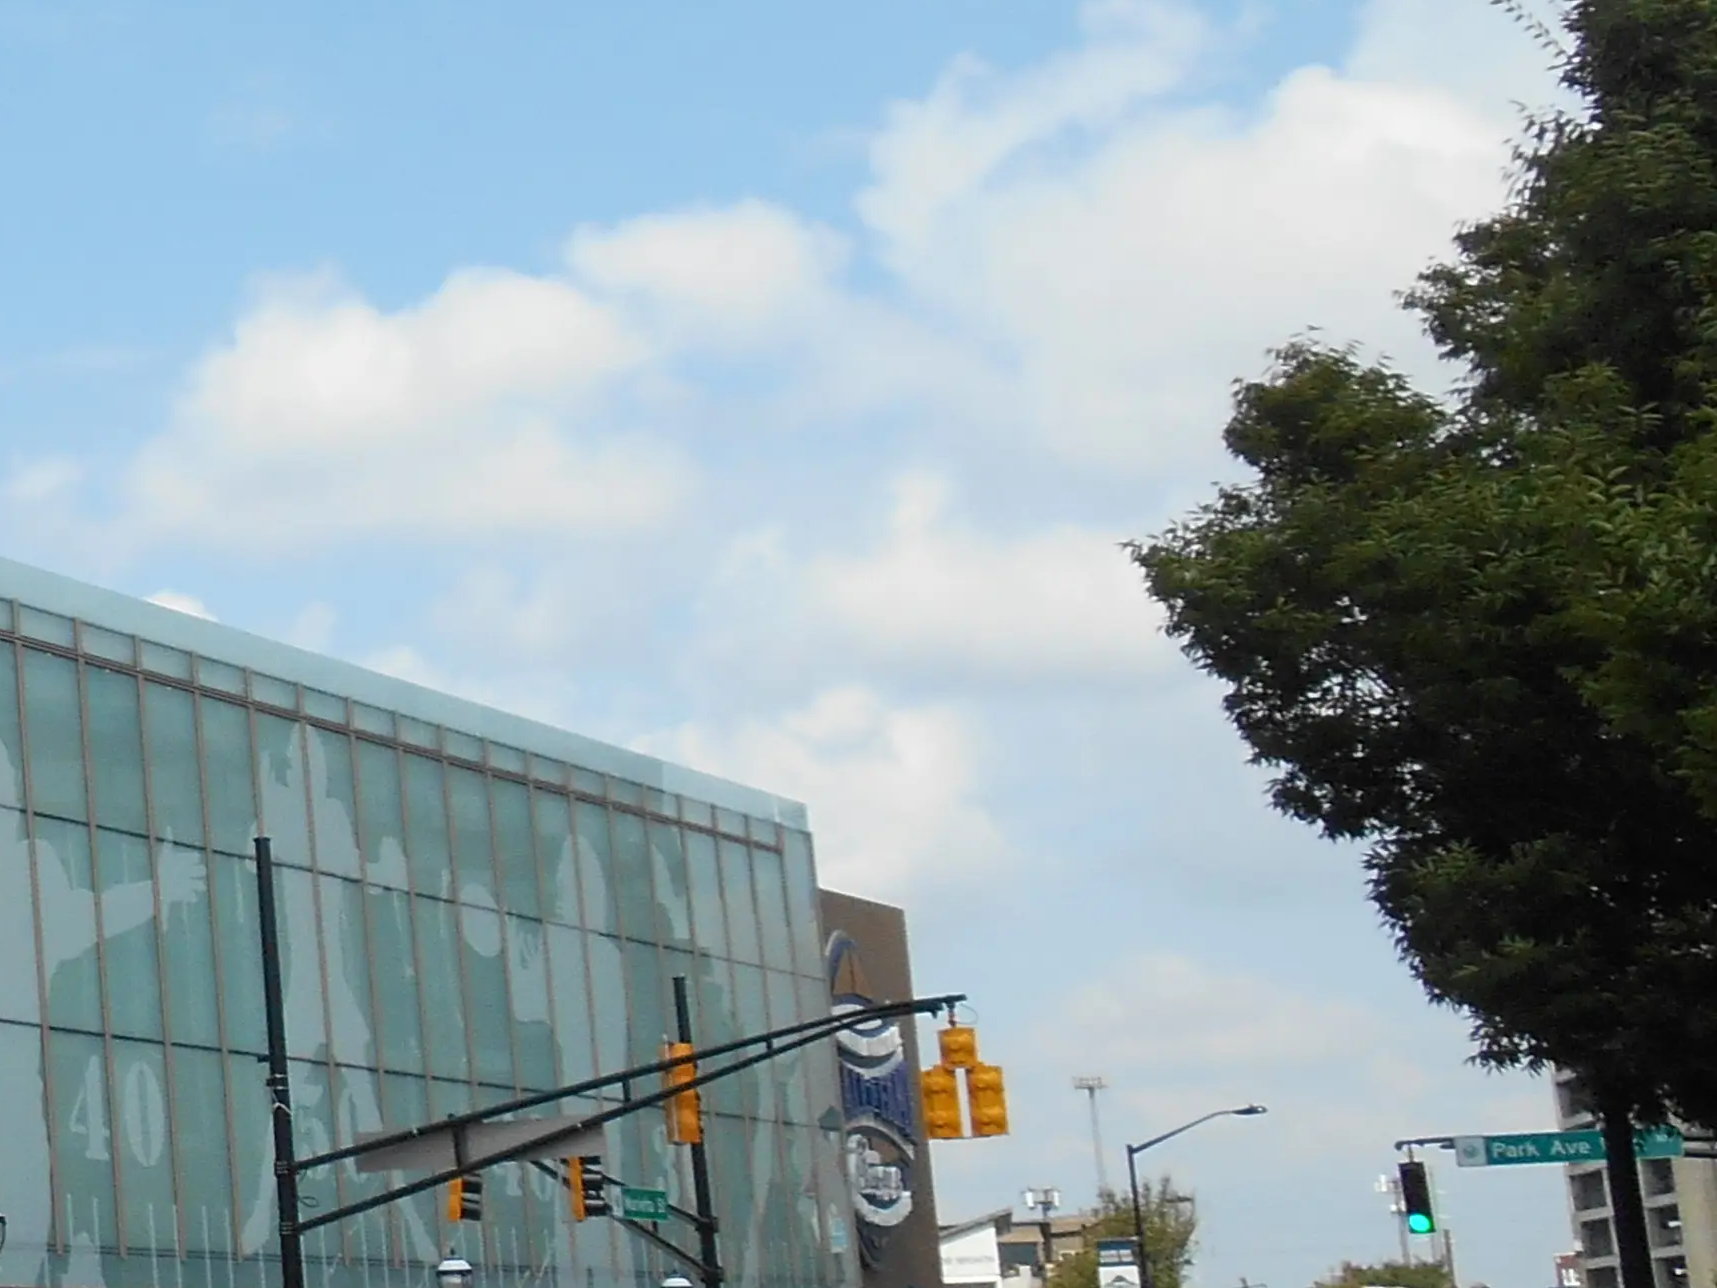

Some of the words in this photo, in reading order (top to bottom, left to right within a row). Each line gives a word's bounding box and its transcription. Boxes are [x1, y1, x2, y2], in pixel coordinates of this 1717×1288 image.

[68, 1055, 165, 1168] 40
[1491, 1142, 1540, 1158] Park
[1550, 1140, 1592, 1155] Ave
